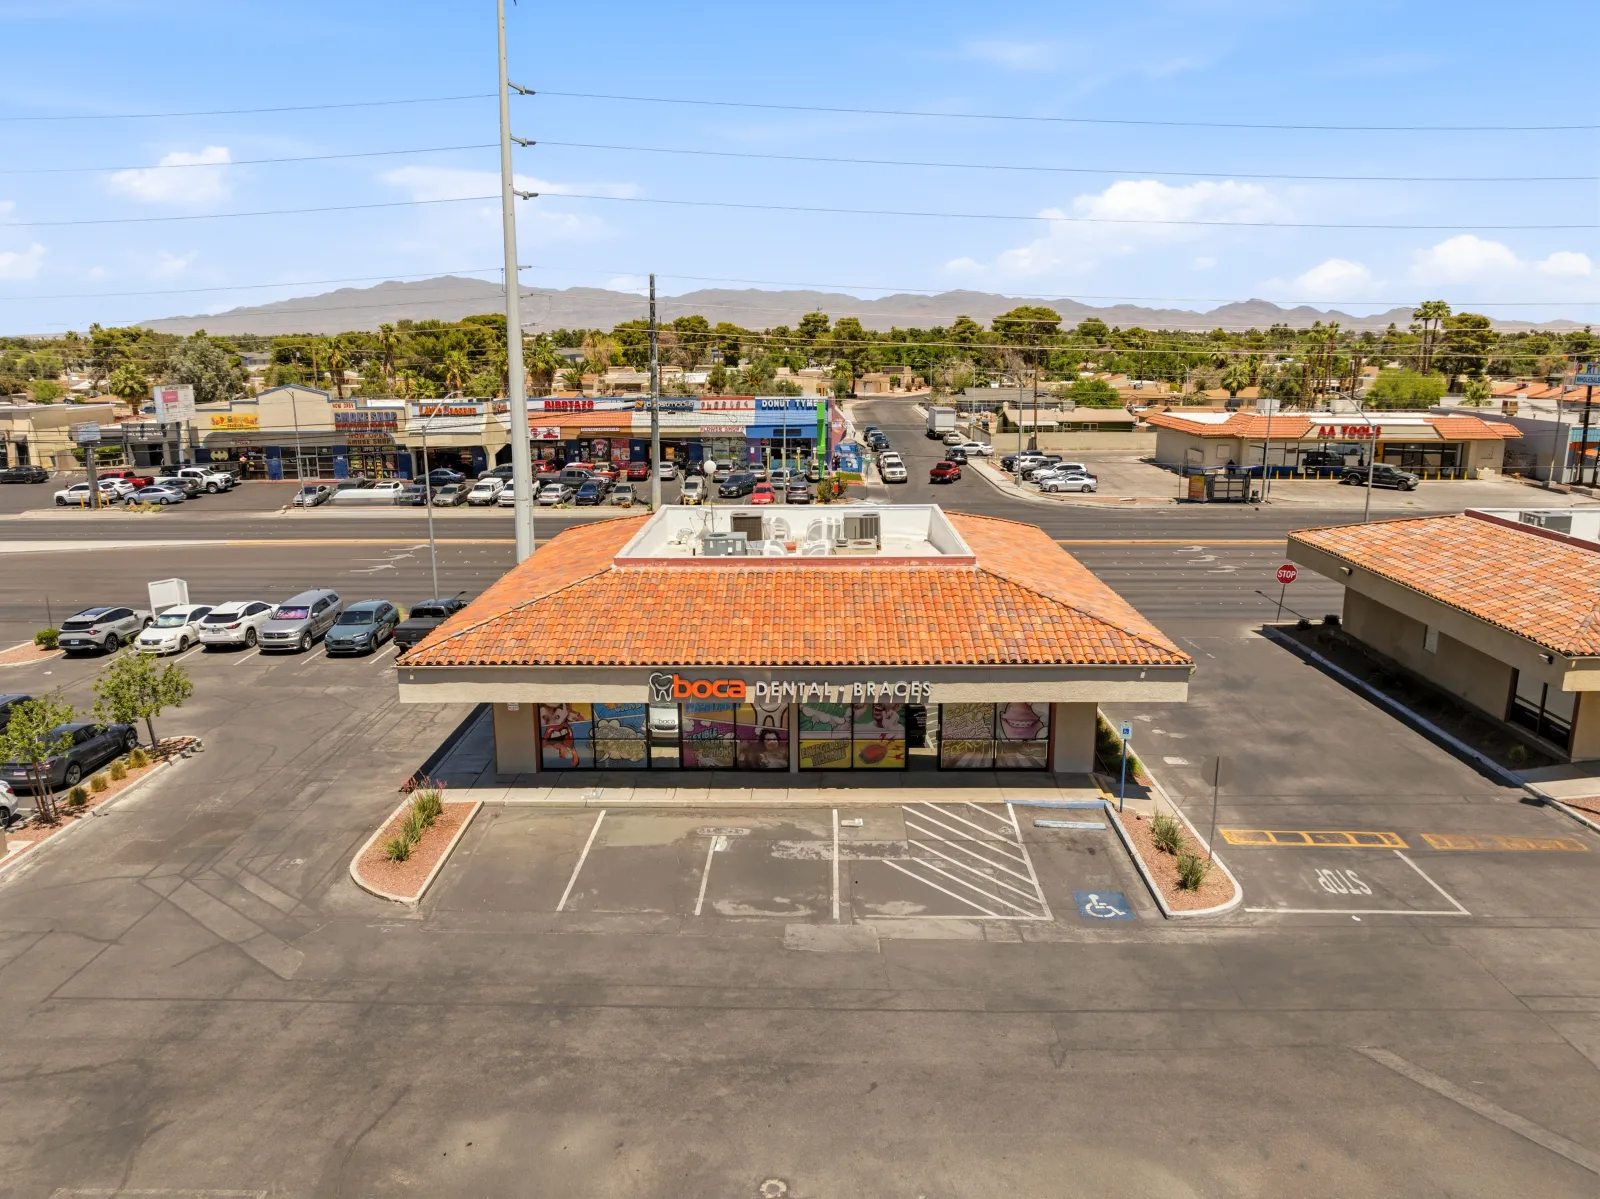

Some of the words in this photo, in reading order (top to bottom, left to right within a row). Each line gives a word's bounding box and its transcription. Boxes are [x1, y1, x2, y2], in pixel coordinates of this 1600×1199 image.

[334, 412, 369, 423] SMOKE
[370, 411, 397, 422] SHOP
[1318, 425, 1336, 437] AA
[1341, 425, 1381, 437] TOOLS
[1277, 570, 1297, 579] STOP
[673, 673, 746, 699] boca
[756, 681, 831, 697] DENTAL
[854, 681, 932, 697] BRACES
[1315, 869, 1372, 894] STOP
